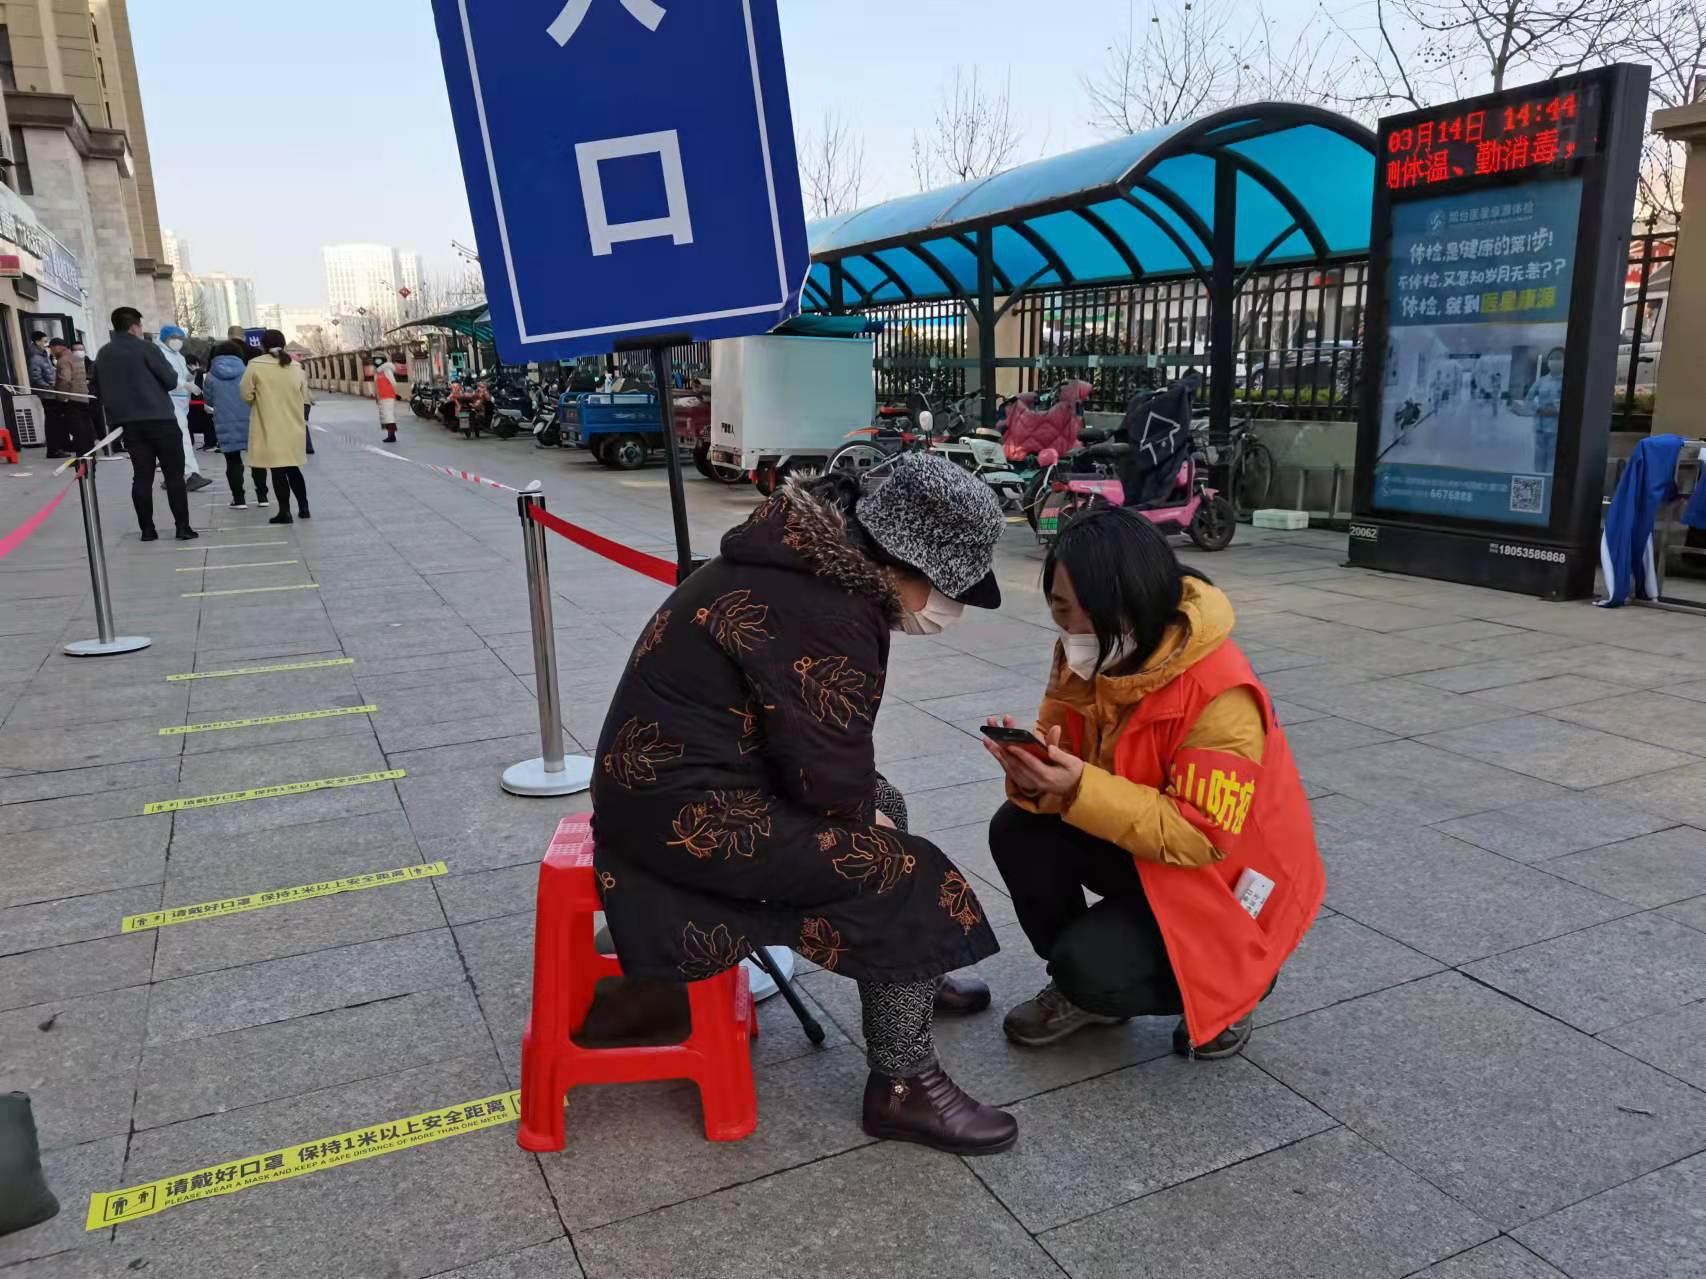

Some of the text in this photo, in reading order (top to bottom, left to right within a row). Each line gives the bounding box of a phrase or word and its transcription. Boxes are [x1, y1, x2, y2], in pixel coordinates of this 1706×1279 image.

[1388, 92, 1576, 154] 03月14日 14:44
[1350, 526, 1377, 539] 20062
[1499, 545, 1566, 564] 18053586868
[165, 1191, 201, 1206] PLEASE
[205, 1183, 232, 1195] WEAR
[244, 1173, 270, 1185] MASK
[273, 1167, 292, 1177] AND
[294, 1161, 318, 1172] KEEP
[329, 1153, 351, 1163] SAFE
[353, 1141, 394, 1157] DISTANCE
[410, 1131, 434, 1142] MORE
[438, 1126, 459, 1134] THAN
[461, 1120, 479, 1128] ONE
[480, 1113, 508, 1124] METER
[166, 1099, 505, 1197] 请戴好口罩 保持1米以上安全距离
